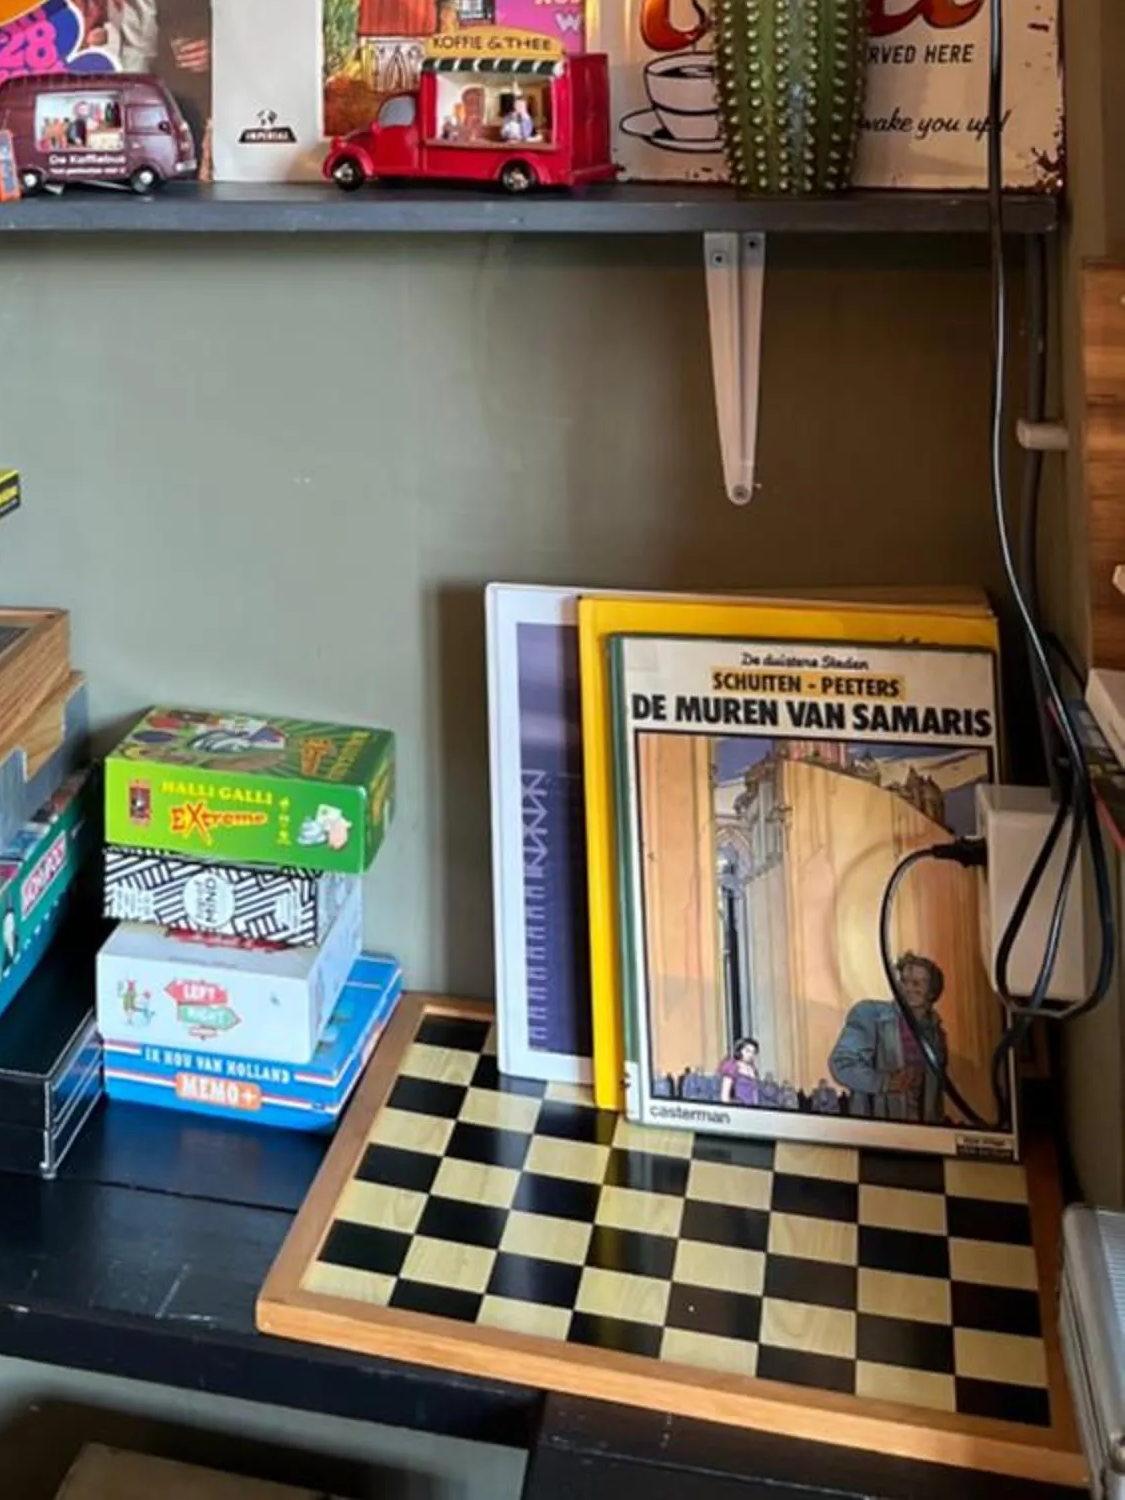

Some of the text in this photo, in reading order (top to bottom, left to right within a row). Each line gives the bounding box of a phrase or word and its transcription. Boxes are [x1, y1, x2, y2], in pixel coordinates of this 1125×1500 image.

[433, 35, 482, 50] KOFFIE
[505, 37, 552, 52] THEE
[869, 43, 975, 66] RVED HERE
[917, 114, 961, 141] you
[712, 671, 802, 693] SCHUITEN
[820, 675, 900, 698] PEETERS
[631, 694, 993, 737] DE MUREN VAN SAMARIS
[161, 780, 274, 806] HALLI GALLI
[182, 983, 218, 1001] LEFT
[163, 1049, 193, 1067] HOU
[196, 1055, 222, 1072] VAN
[226, 1061, 291, 1084] HOLLAND
[649, 1105, 732, 1125] casterman
